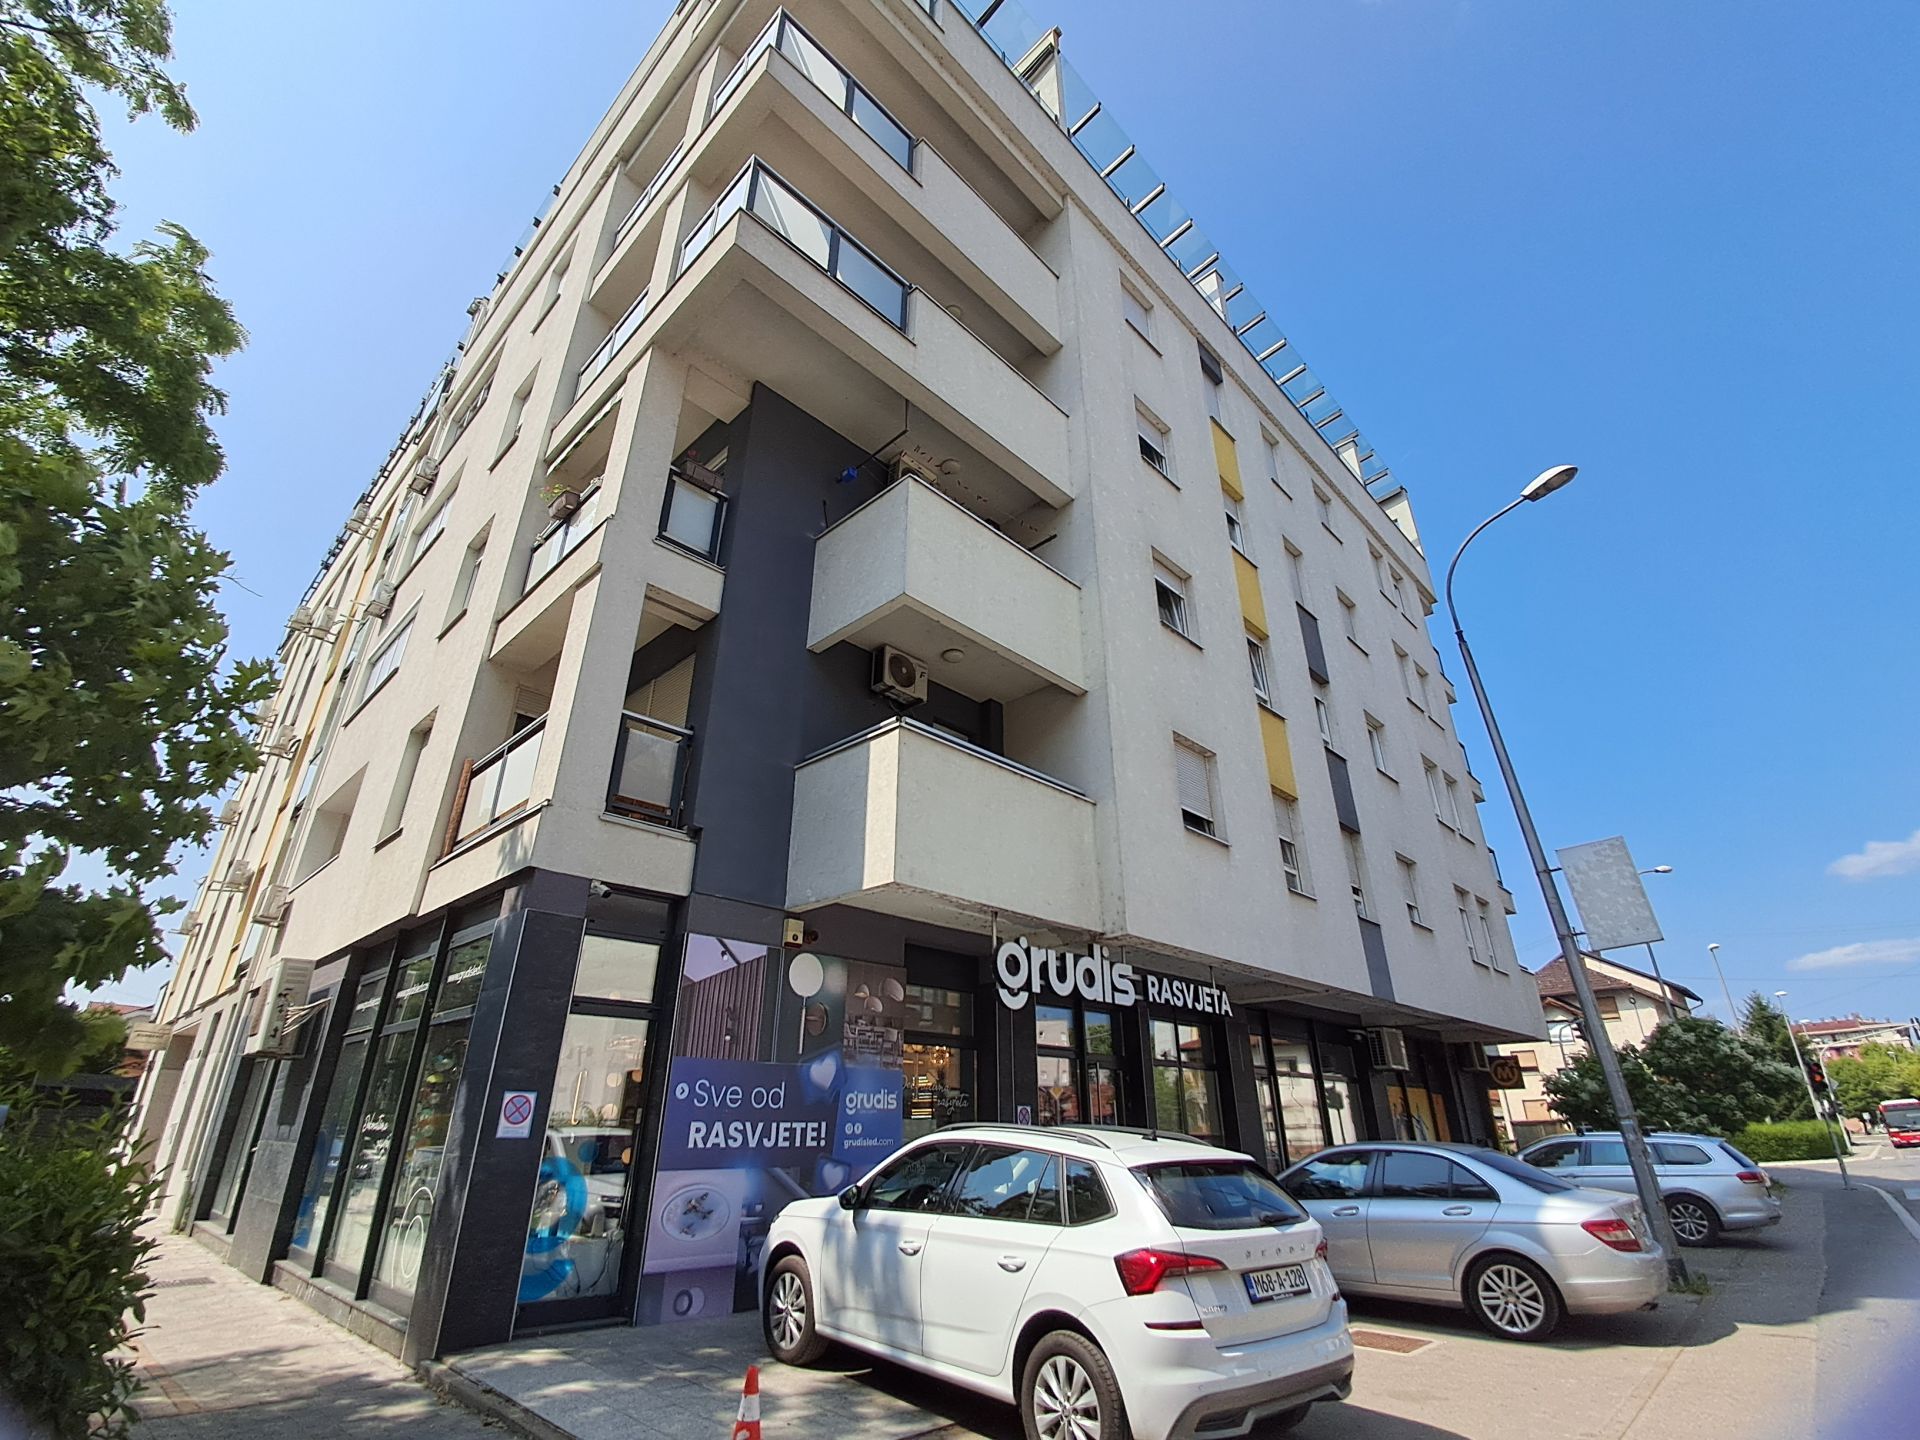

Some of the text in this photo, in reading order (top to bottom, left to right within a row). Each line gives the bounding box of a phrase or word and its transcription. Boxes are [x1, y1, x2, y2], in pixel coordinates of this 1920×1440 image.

[996, 936, 1233, 1017] grudis RASVJETA
[693, 1079, 785, 1109] Sve od
[845, 1088, 898, 1116] grudis
[687, 1120, 827, 1149] RASVJETE!
[843, 1137, 895, 1150] grudisled.com
[1252, 1267, 1306, 1295] M68-A-128
